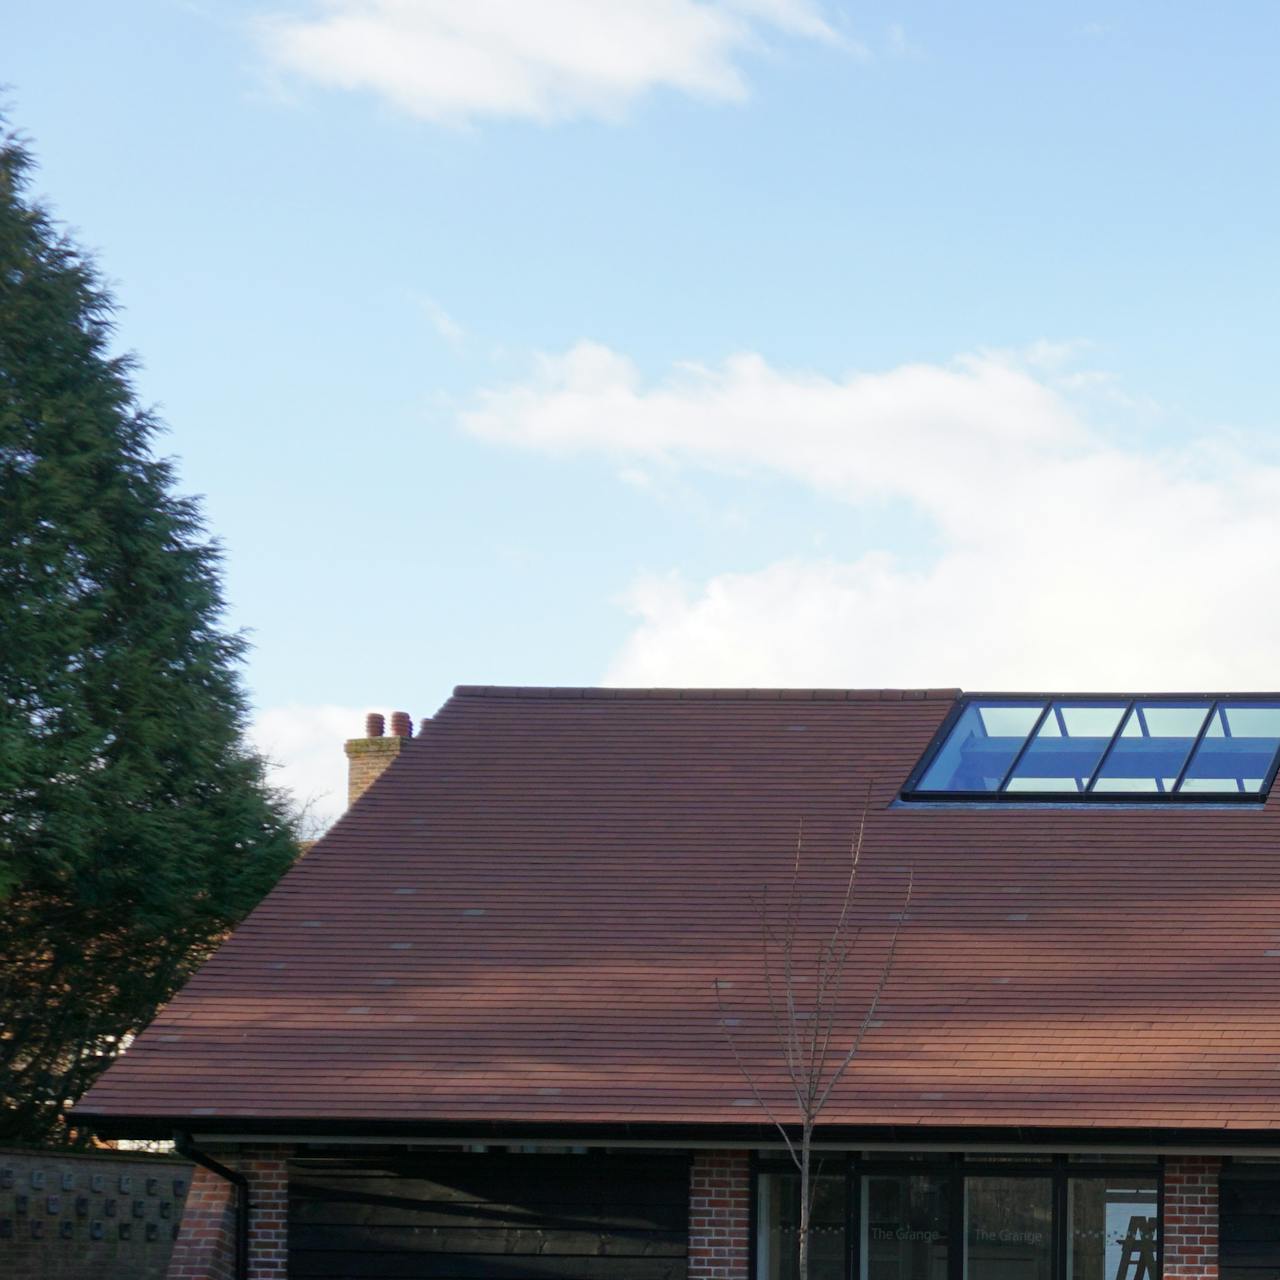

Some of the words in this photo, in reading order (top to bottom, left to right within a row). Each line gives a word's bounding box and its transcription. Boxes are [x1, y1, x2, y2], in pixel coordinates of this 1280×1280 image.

[871, 1227, 894, 1240] The
[895, 1228, 940, 1244] Grange
[975, 1229, 997, 1241] The
[999, 1229, 1043, 1245] Grange
